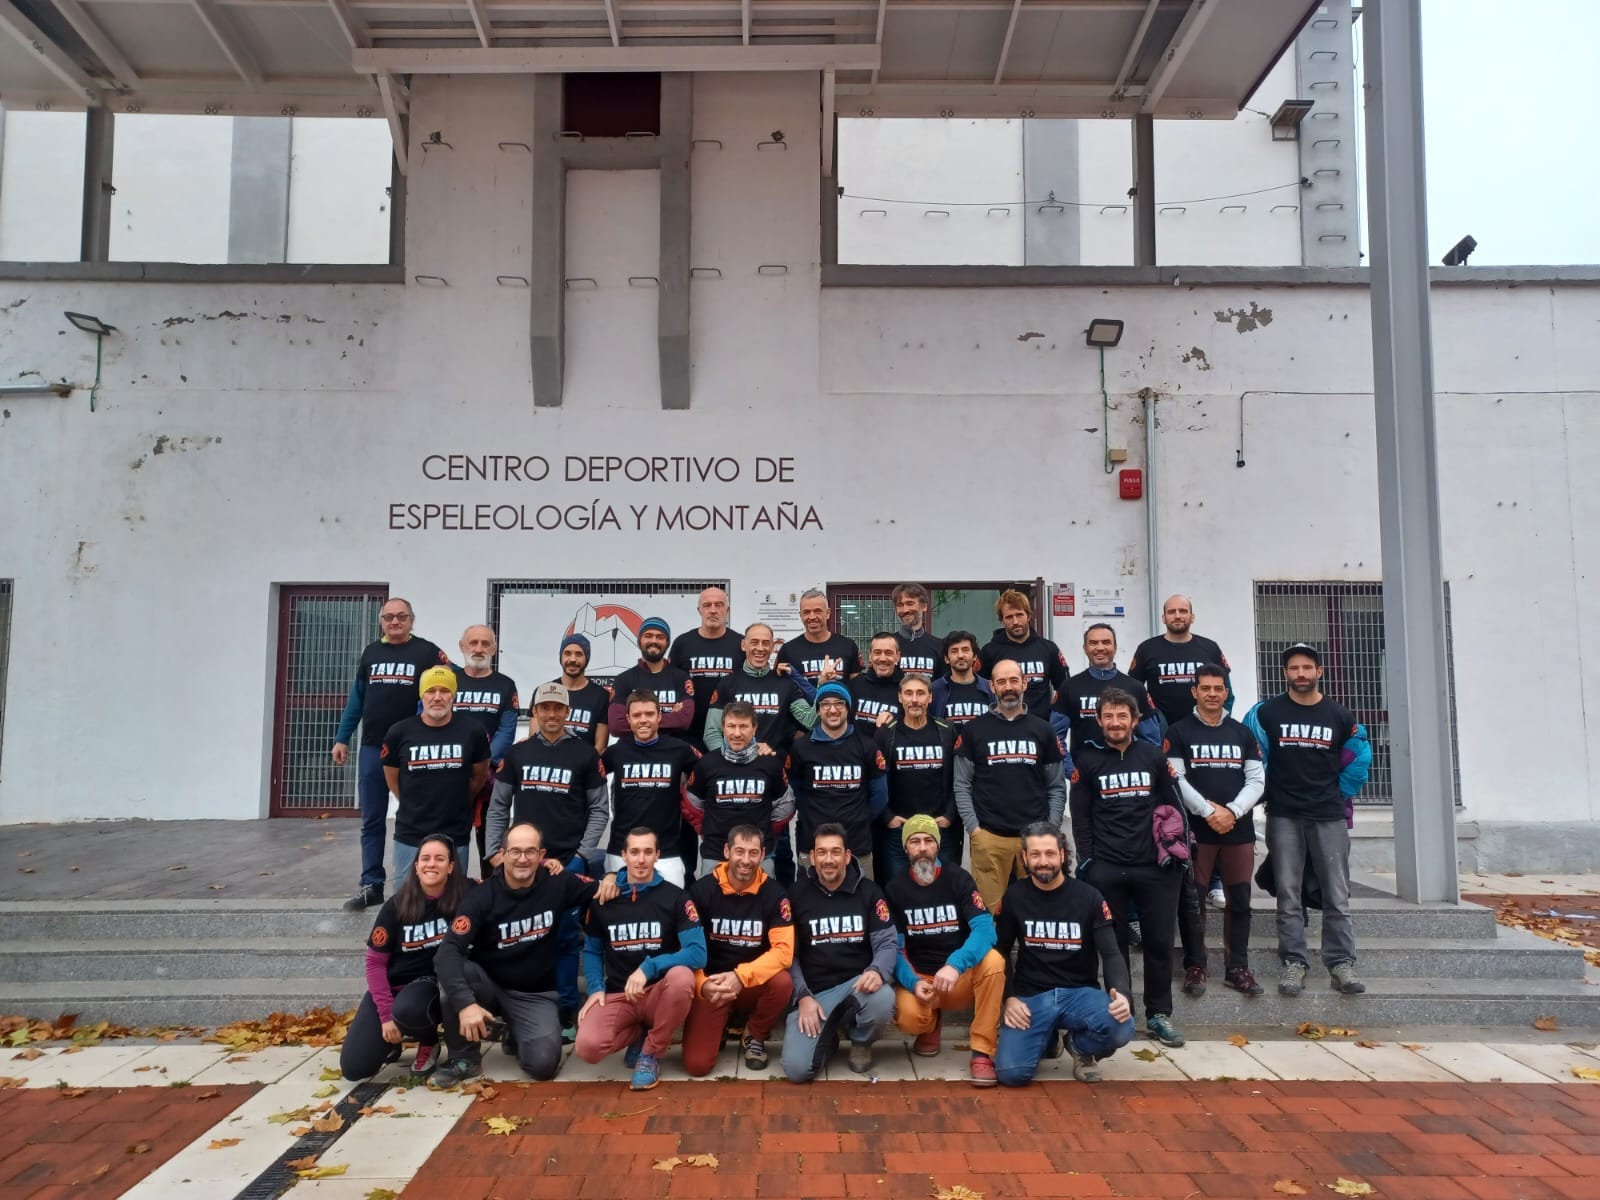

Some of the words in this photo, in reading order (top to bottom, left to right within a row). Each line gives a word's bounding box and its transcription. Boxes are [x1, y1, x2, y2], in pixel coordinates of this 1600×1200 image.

[422, 454, 550, 482] CENTRO
[564, 455, 740, 483] DEPORTIVO
[755, 456, 795, 483] DE
[388, 498, 622, 530] ESPELEOLOGÍA
[629, 504, 648, 530] Y
[656, 501, 824, 531] MONTAÑA
[370, 663, 416, 677] TAVAD
[690, 657, 733, 669] TAVAD
[899, 656, 934, 669] AVAD
[455, 691, 502, 705] TAVAD
[1280, 724, 1333, 741] TAVAD
[409, 744, 463, 761] TAVAD
[896, 746, 944, 761] TAVAD
[988, 740, 1037, 756] TAVAD
[1190, 744, 1242, 760] TAVAD
[522, 765, 572, 784] TAVAD
[622, 763, 672, 779] TAVAD
[813, 766, 862, 781] TAVAD
[716, 780, 766, 796] TAVAD
[1099, 772, 1152, 790] TAVAD
[905, 905, 958, 926] TAVAD
[403, 917, 449, 943] TAVA
[498, 910, 554, 939] TAVAD
[607, 922, 661, 942] TAVAD
[711, 918, 763, 937] TAVAD
[809, 915, 864, 937] TAVAD
[1025, 920, 1082, 939] TAVAD
